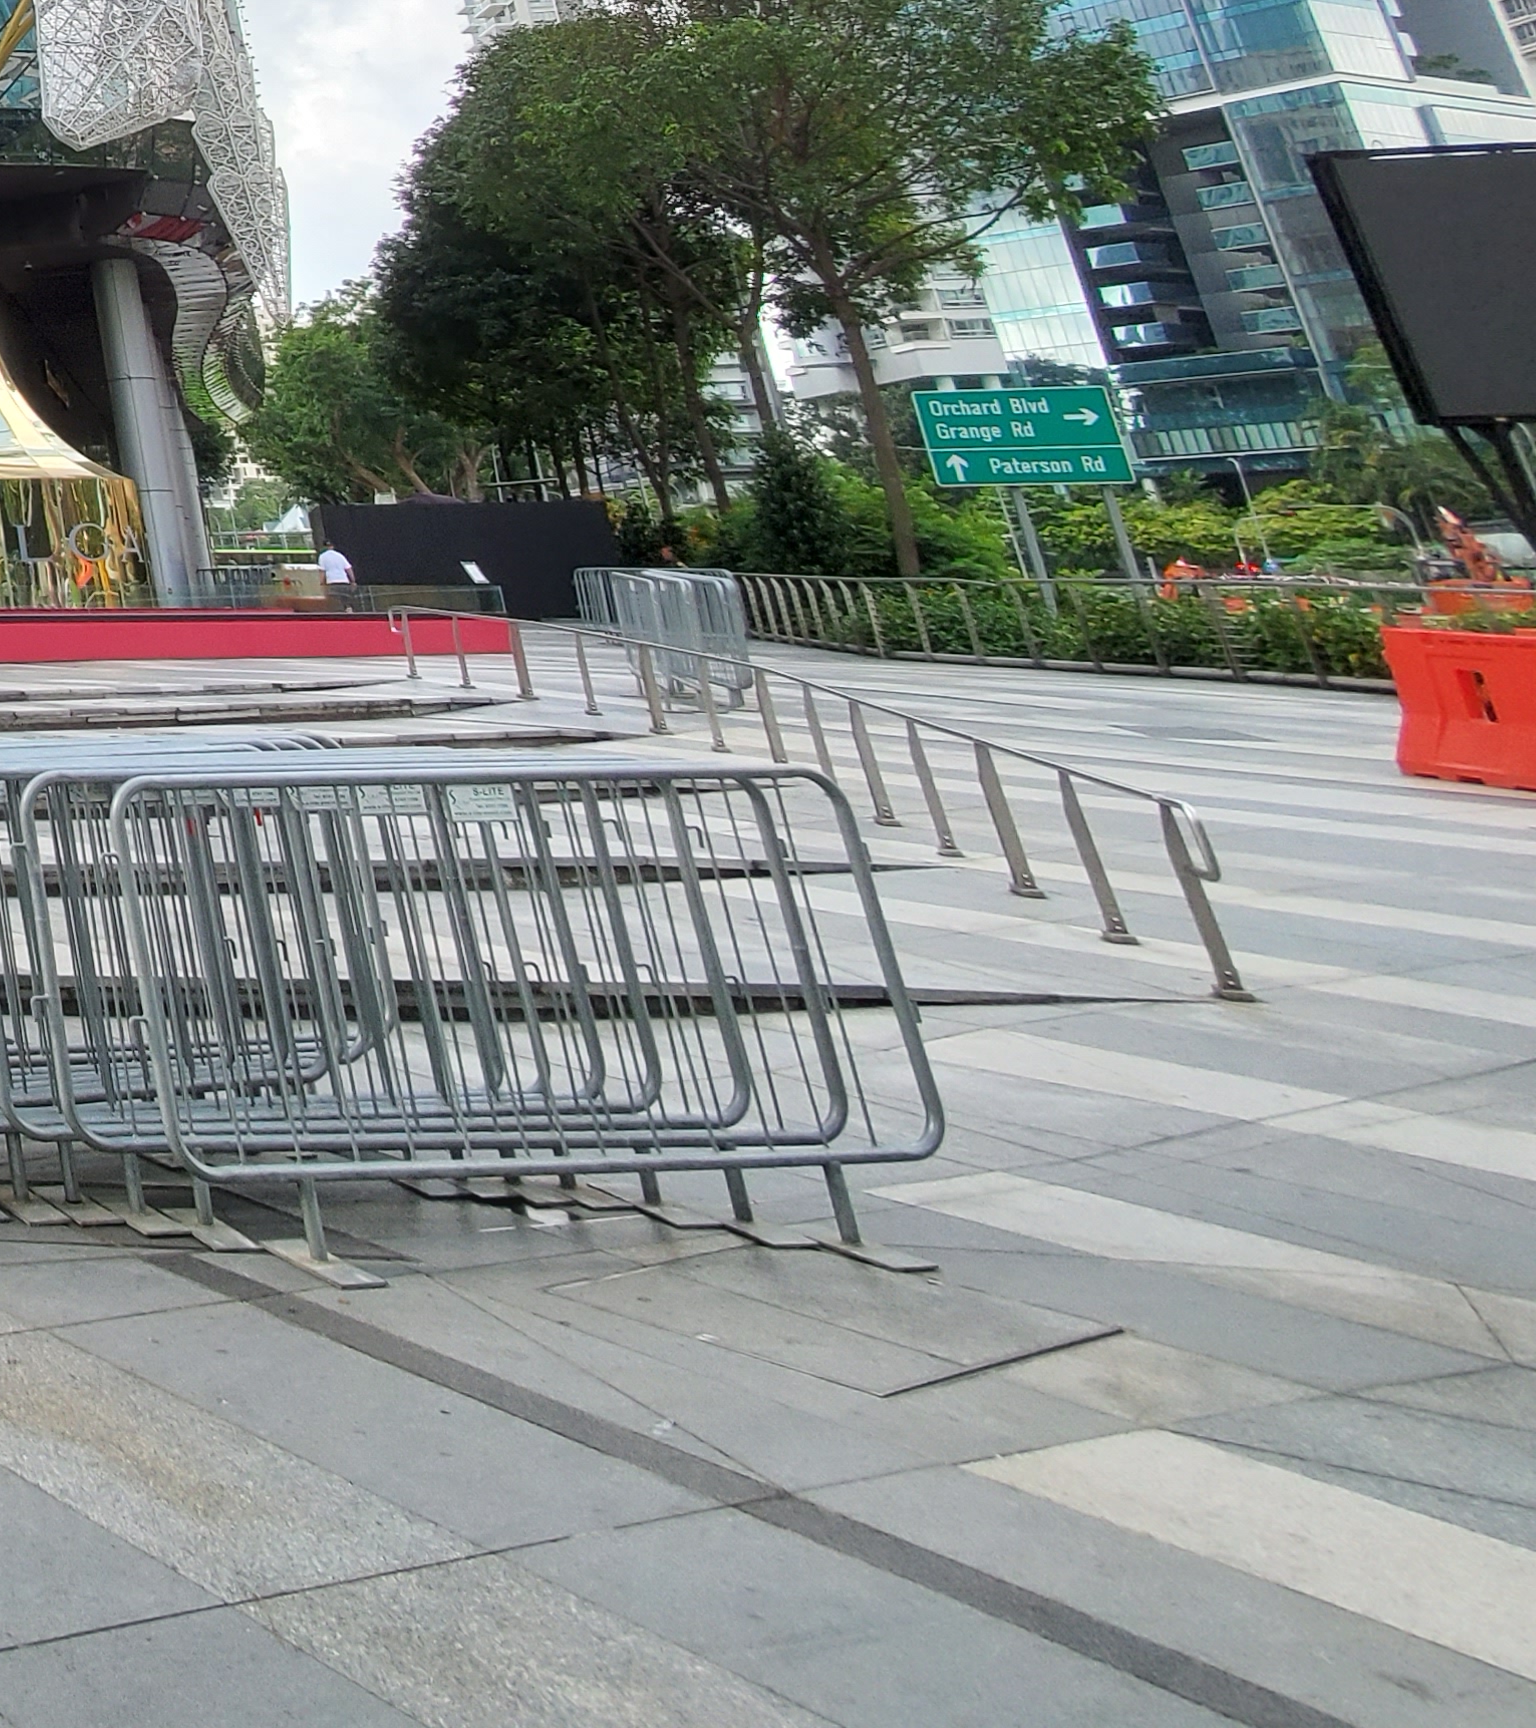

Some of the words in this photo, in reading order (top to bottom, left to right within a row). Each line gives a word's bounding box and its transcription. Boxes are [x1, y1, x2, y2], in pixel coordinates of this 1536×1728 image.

[928, 398, 1003, 417] Orchard
[1008, 396, 1050, 414] Blvd
[935, 421, 1002, 442] Grange
[1009, 419, 1035, 438] Rd
[989, 456, 1073, 474] Paterson
[1081, 454, 1106, 472] Rd
[472, 786, 505, 796] S-LITE
